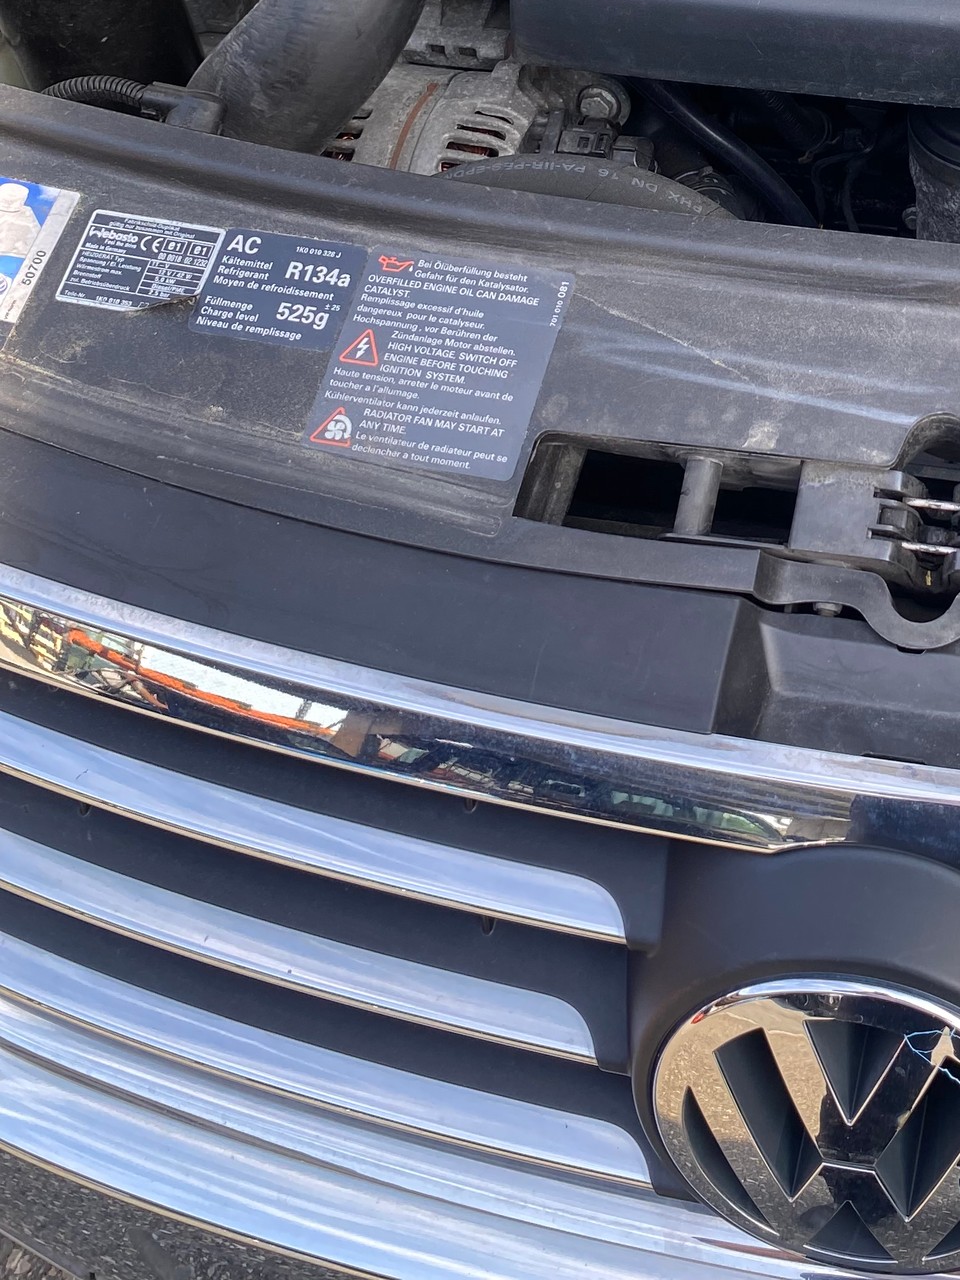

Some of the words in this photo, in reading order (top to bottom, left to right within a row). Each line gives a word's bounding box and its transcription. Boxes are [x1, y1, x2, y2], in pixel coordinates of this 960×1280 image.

[598, 167, 619, 180] 16
[631, 177, 657, 193] DN
[668, 190, 703, 214] PHX
[89, 226, 139, 243] Webasto
[226, 234, 262, 254] AC
[221, 255, 274, 270] Kältemittel
[296, 246, 309, 254] 1K0
[336, 251, 342, 259] J
[22, 250, 46, 286] 50700
[217, 265, 270, 281] Refrigerant
[285, 261, 352, 287] R134a
[417, 259, 432, 269] Bei
[433, 260, 493, 279] Ölüberfüllung
[493, 270, 529, 283] besteht
[213, 275, 245, 288] Moyen
[246, 280, 260, 290] de
[260, 283, 335, 301] refroidissement
[364, 284, 411, 299] CATALYST.
[368, 274, 422, 289] OVERFILLED
[422, 282, 459, 295] ENGINE
[459, 287, 474, 297] OIL
[475, 289, 497, 300] CAN
[497, 292, 540, 307] DAMAGE
[414, 269, 445, 281] Gefahr
[445, 273, 459, 283] für
[459, 276, 480, 286] den
[477, 279, 529, 294] Katalysator.
[557, 281, 570, 299] 081
[200, 306, 234, 320] Charge
[235, 311, 260, 323] level
[204, 295, 253, 312] Füllmenge
[360, 293, 416, 309] Remplissage
[417, 303, 455, 314] excessif
[454, 307, 485, 319] d'huile
[554, 300, 564, 313] 010
[276, 302, 330, 330] 525g
[357, 304, 403, 318] dangereux
[405, 312, 428, 321] pour
[428, 314, 437, 323] le
[438, 316, 486, 330] catalyseur.
[549, 314, 559, 327] 701
[196, 316, 229, 329] Niveau
[231, 322, 244, 331] de
[245, 325, 302, 341] remplissage
[424, 325, 441, 333] vor
[440, 326, 481, 340] Berühren
[482, 332, 499, 342] der
[387, 341, 413, 353] HIGH
[458, 351, 498, 366] SWITCH
[498, 358, 518, 368] OFF
[391, 330, 444, 346] Zündanlage
[444, 338, 473, 350] Motor
[473, 343, 517, 357] abstellen.
[379, 363, 422, 378] IGNITION
[425, 370, 467, 385] SYSTEM.
[383, 352, 419, 366] ENGINE
[419, 357, 457, 371] BEFORE
[458, 363, 509, 379] TOUCHING
[329, 379, 364, 391] toucher
[333, 366, 360, 378] Haute
[362, 371, 396, 385] tension,
[398, 378, 429, 389] arreter
[430, 381, 439, 391] le
[440, 385, 474, 396] moteur
[474, 390, 501, 400] avant
[501, 393, 514, 402] de
[324, 390, 395, 408] Kühlerventilator
[396, 401, 419, 412] kann
[418, 404, 460, 419] jederzeit
[460, 412, 502, 425] anlaufen.
[358, 419, 381, 430] ANY
[363, 407, 413, 424] RADIATOR
[413, 415, 434, 427] FAN
[434, 419, 458, 431] MAY
[458, 422, 491, 435] START
[490, 428, 506, 437] AT
[351, 443, 401, 458] declencher
[402, 452, 409, 460] a
[410, 452, 430, 463] tout
[430, 457, 471, 470] moment.
[355, 430, 367, 441] Le
[368, 433, 417, 449] ventilateur
[417, 441, 430, 451] de
[430, 444, 473, 458] radiateur
[473, 451, 496, 461] peut
